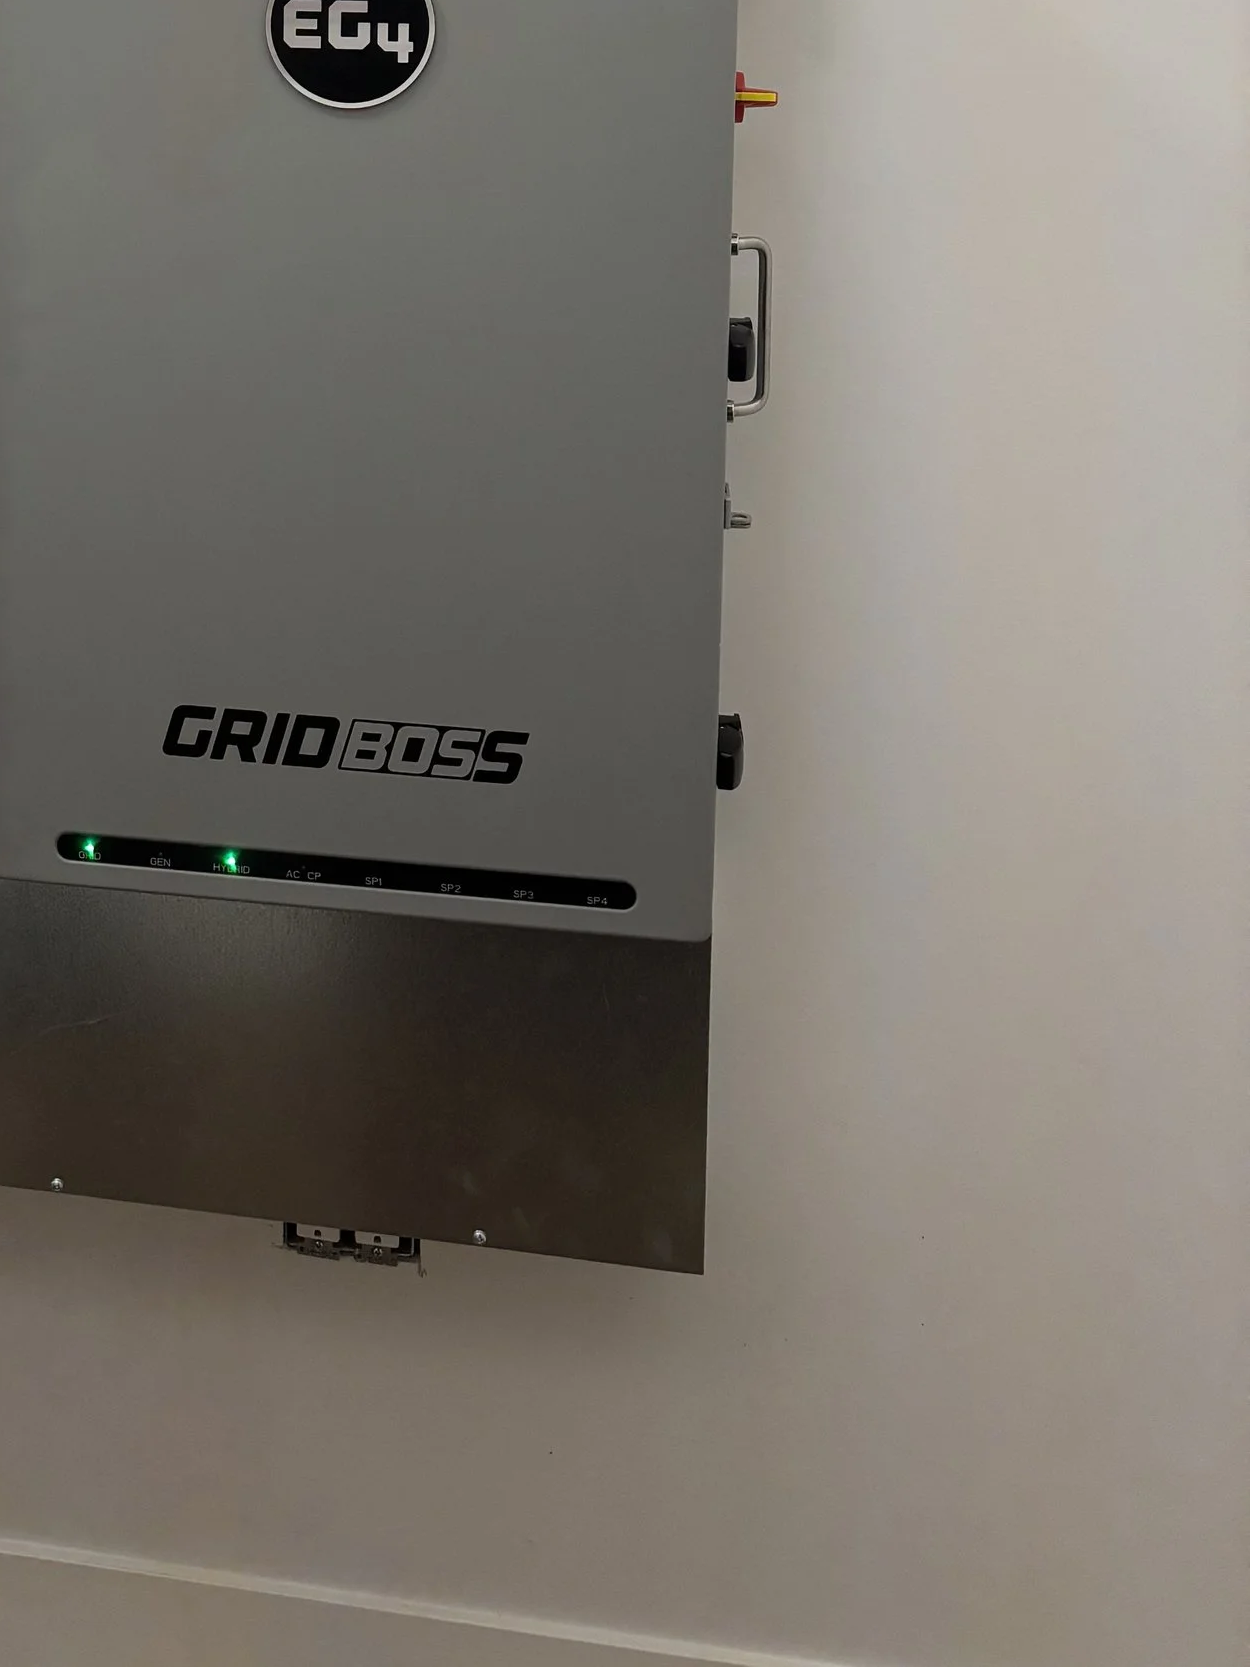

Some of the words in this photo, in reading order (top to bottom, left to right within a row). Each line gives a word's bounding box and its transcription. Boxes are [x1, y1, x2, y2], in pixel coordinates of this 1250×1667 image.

[78, 850, 102, 861] GD
[149, 857, 171, 868] GEN
[285, 869, 301, 880] AC
[307, 871, 322, 882] CP
[364, 876, 383, 887] SP1
[440, 882, 462, 894] SP2
[513, 889, 534, 900] SP3
[586, 895, 608, 906] SP4
